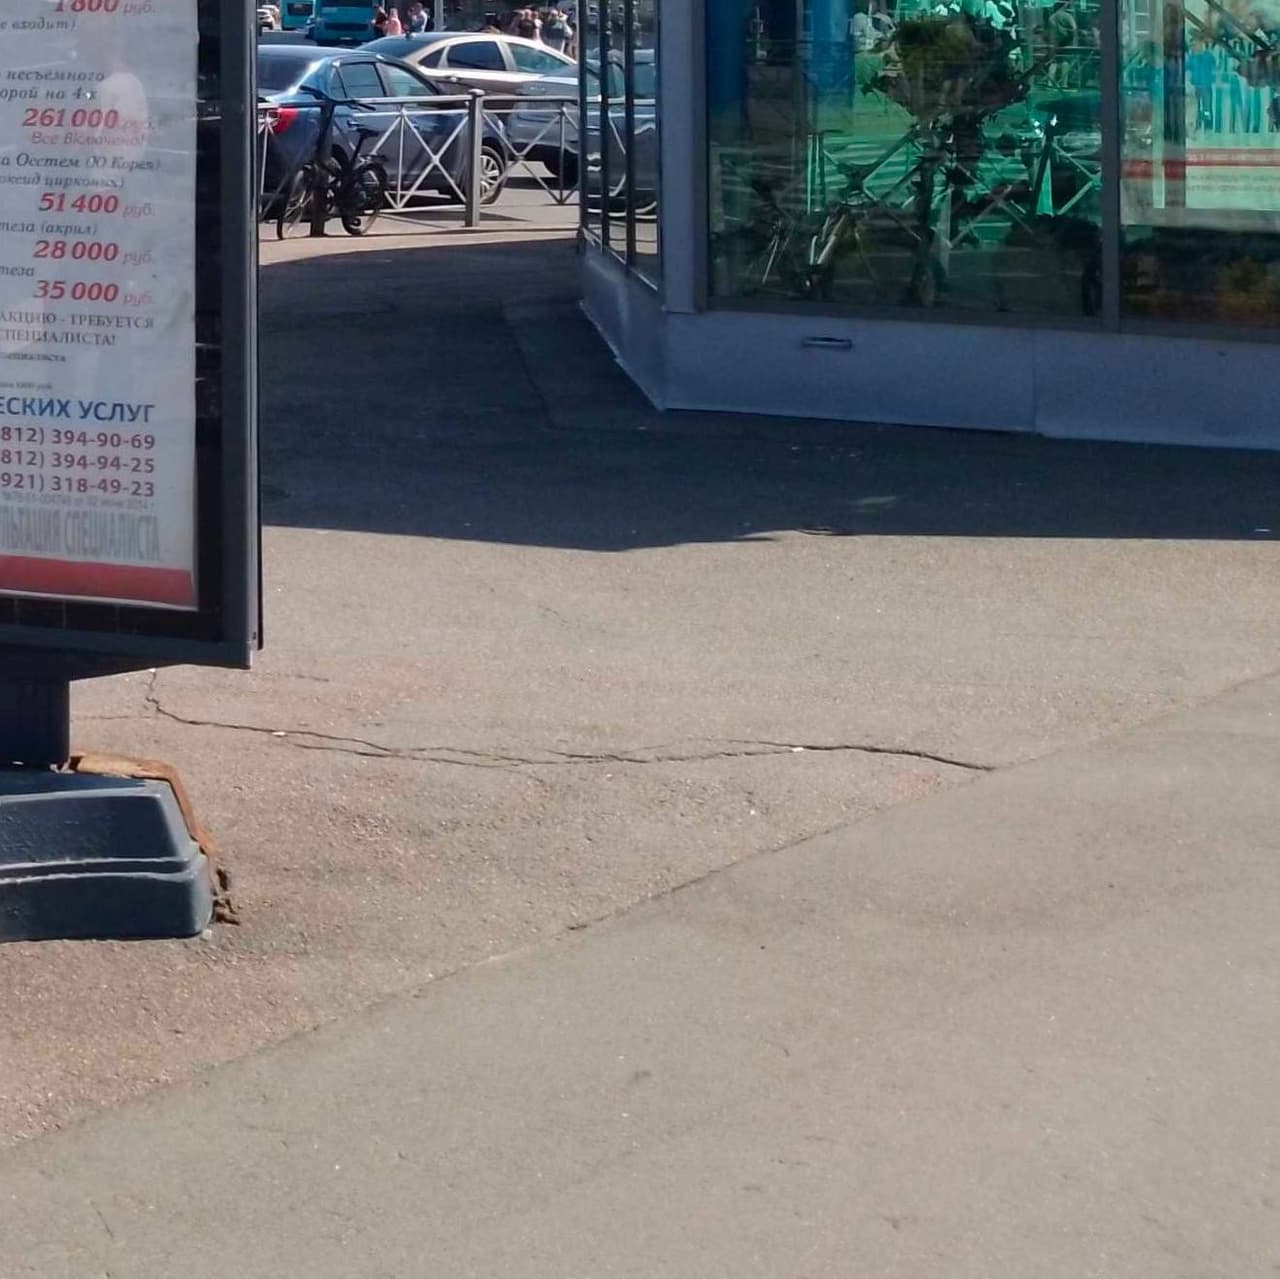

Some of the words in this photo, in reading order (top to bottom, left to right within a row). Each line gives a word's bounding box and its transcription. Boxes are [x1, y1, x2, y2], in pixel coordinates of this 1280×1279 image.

[46, 89, 65, 99] на
[40, 221, 98, 236] (акрил)
[69, 313, 155, 329] ТРЕБУЕТСЯ
[78, 400, 156, 423] УСЛУГ
[51, 429, 156, 450] 394-90-69
[51, 453, 156, 474] 394-94-25
[51, 476, 156, 498] 318-49-23
